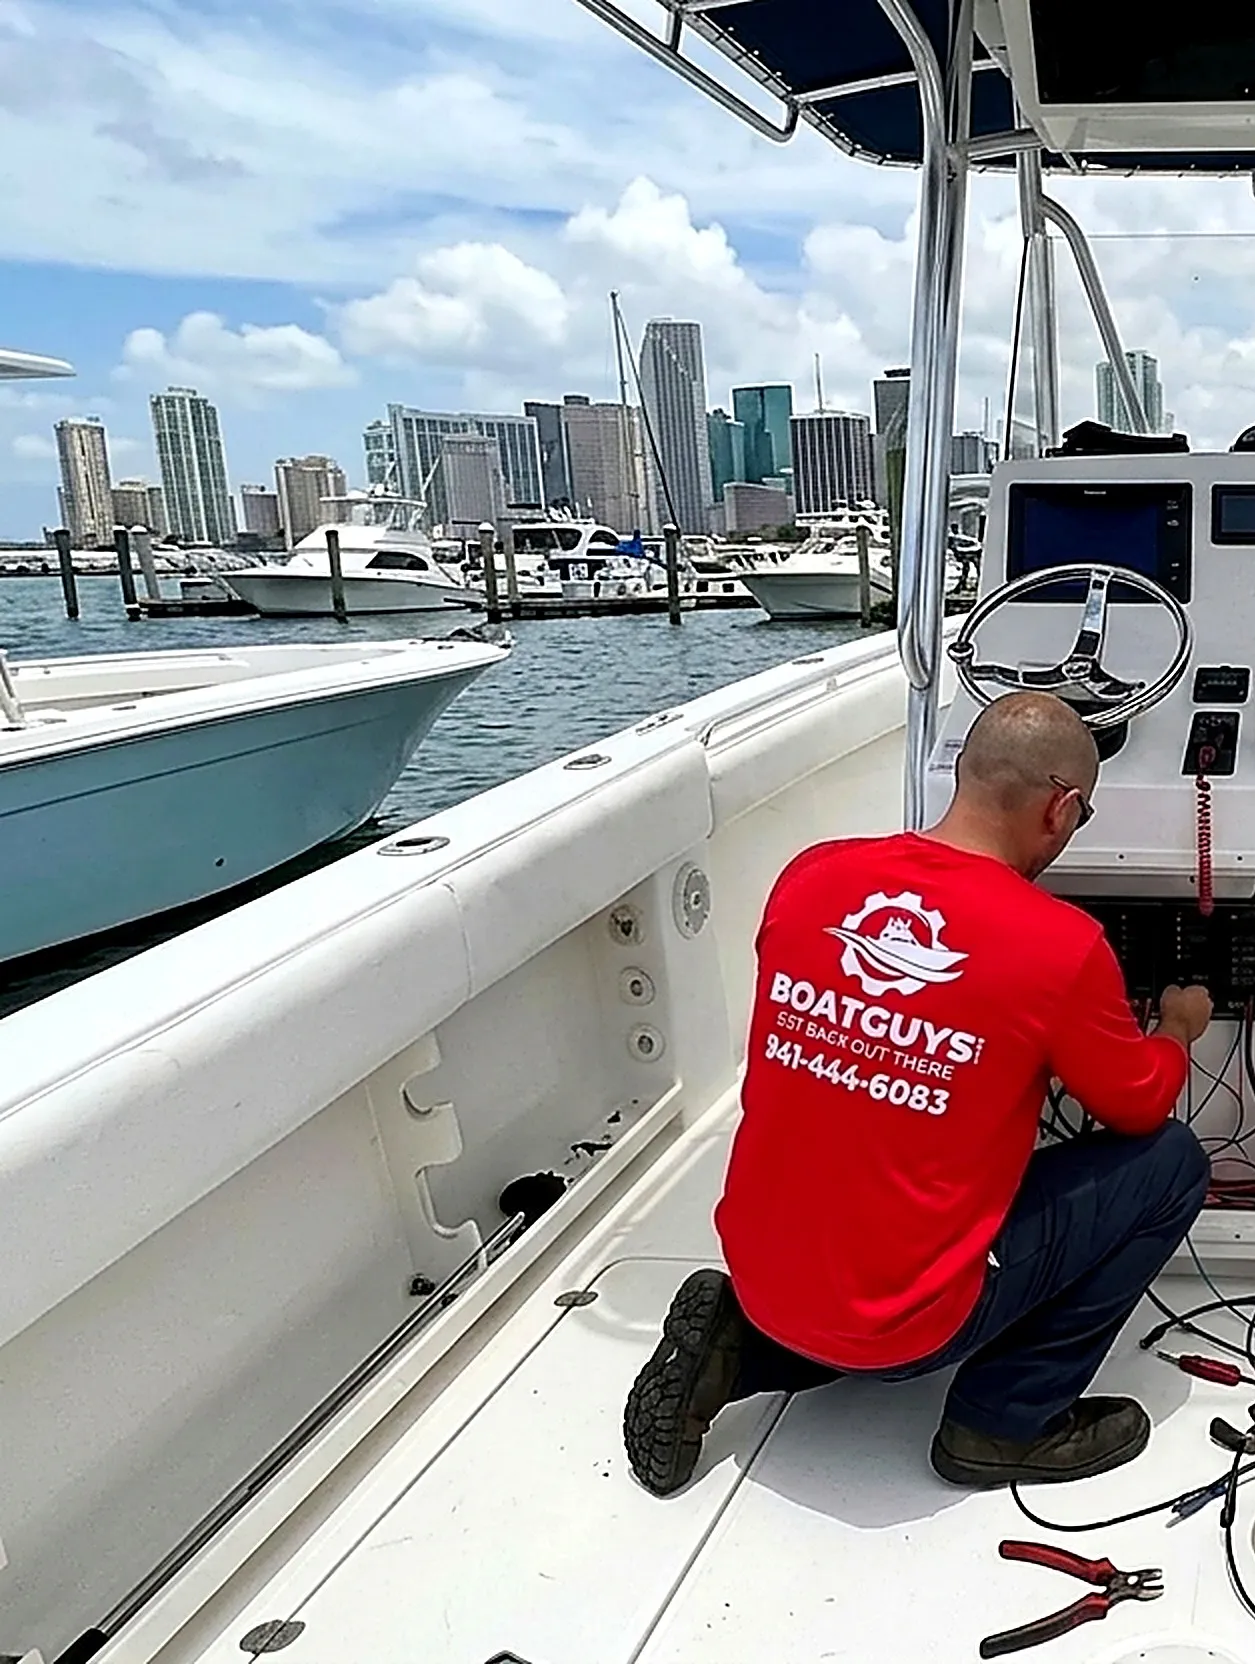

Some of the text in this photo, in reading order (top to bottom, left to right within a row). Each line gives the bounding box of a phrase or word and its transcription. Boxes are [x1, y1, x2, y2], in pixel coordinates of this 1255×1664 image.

[770, 973, 976, 1062] BOATGUYS
[850, 1039, 890, 1062] OUT
[893, 1050, 955, 1081] THERE
